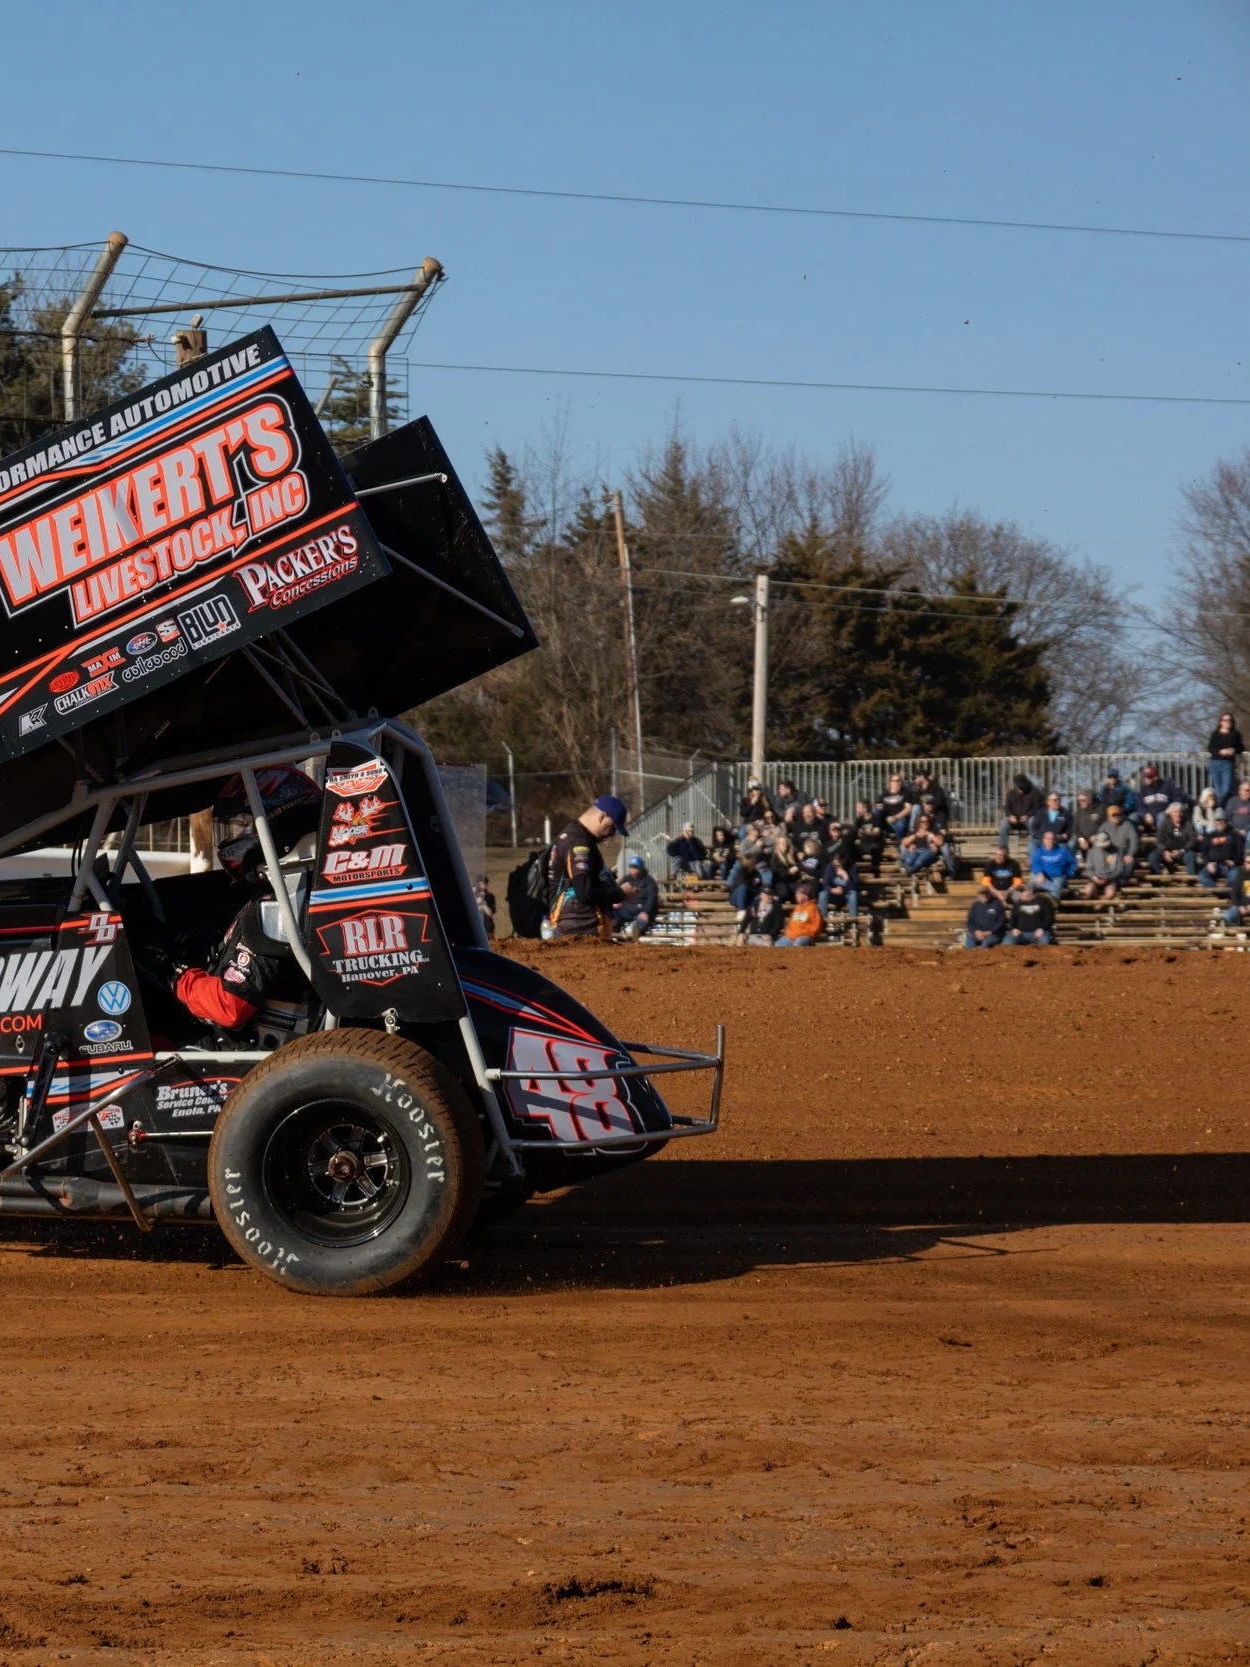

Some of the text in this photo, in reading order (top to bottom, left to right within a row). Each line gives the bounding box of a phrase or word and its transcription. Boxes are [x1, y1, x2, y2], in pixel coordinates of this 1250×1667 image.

[109, 343, 261, 435] AUTOMOTIVE
[70, 472, 305, 623] LIVESTOCK, INC
[234, 525, 357, 612] PACKER'S
[271, 556, 358, 608] Concessions
[81, 647, 126, 678] MAXIM
[122, 637, 188, 682] wilwood
[56, 675, 113, 711] CHALKSTIX
[340, 772, 359, 782] SMITH
[366, 768, 383, 777] SONS
[333, 867, 400, 883] MOTORSPORTS
[340, 914, 408, 957] RLR
[332, 949, 423, 974] TRUCKING
[342, 965, 419, 983] Hanover, PA
[79, 1040, 134, 1056] SUBARU
[157, 1097, 194, 1110] Service
[506, 1028, 637, 1148] 48
[207, 1104, 222, 1114] PA
[370, 1073, 446, 1183] Hoosier
[224, 1167, 300, 1276] Hoosier
